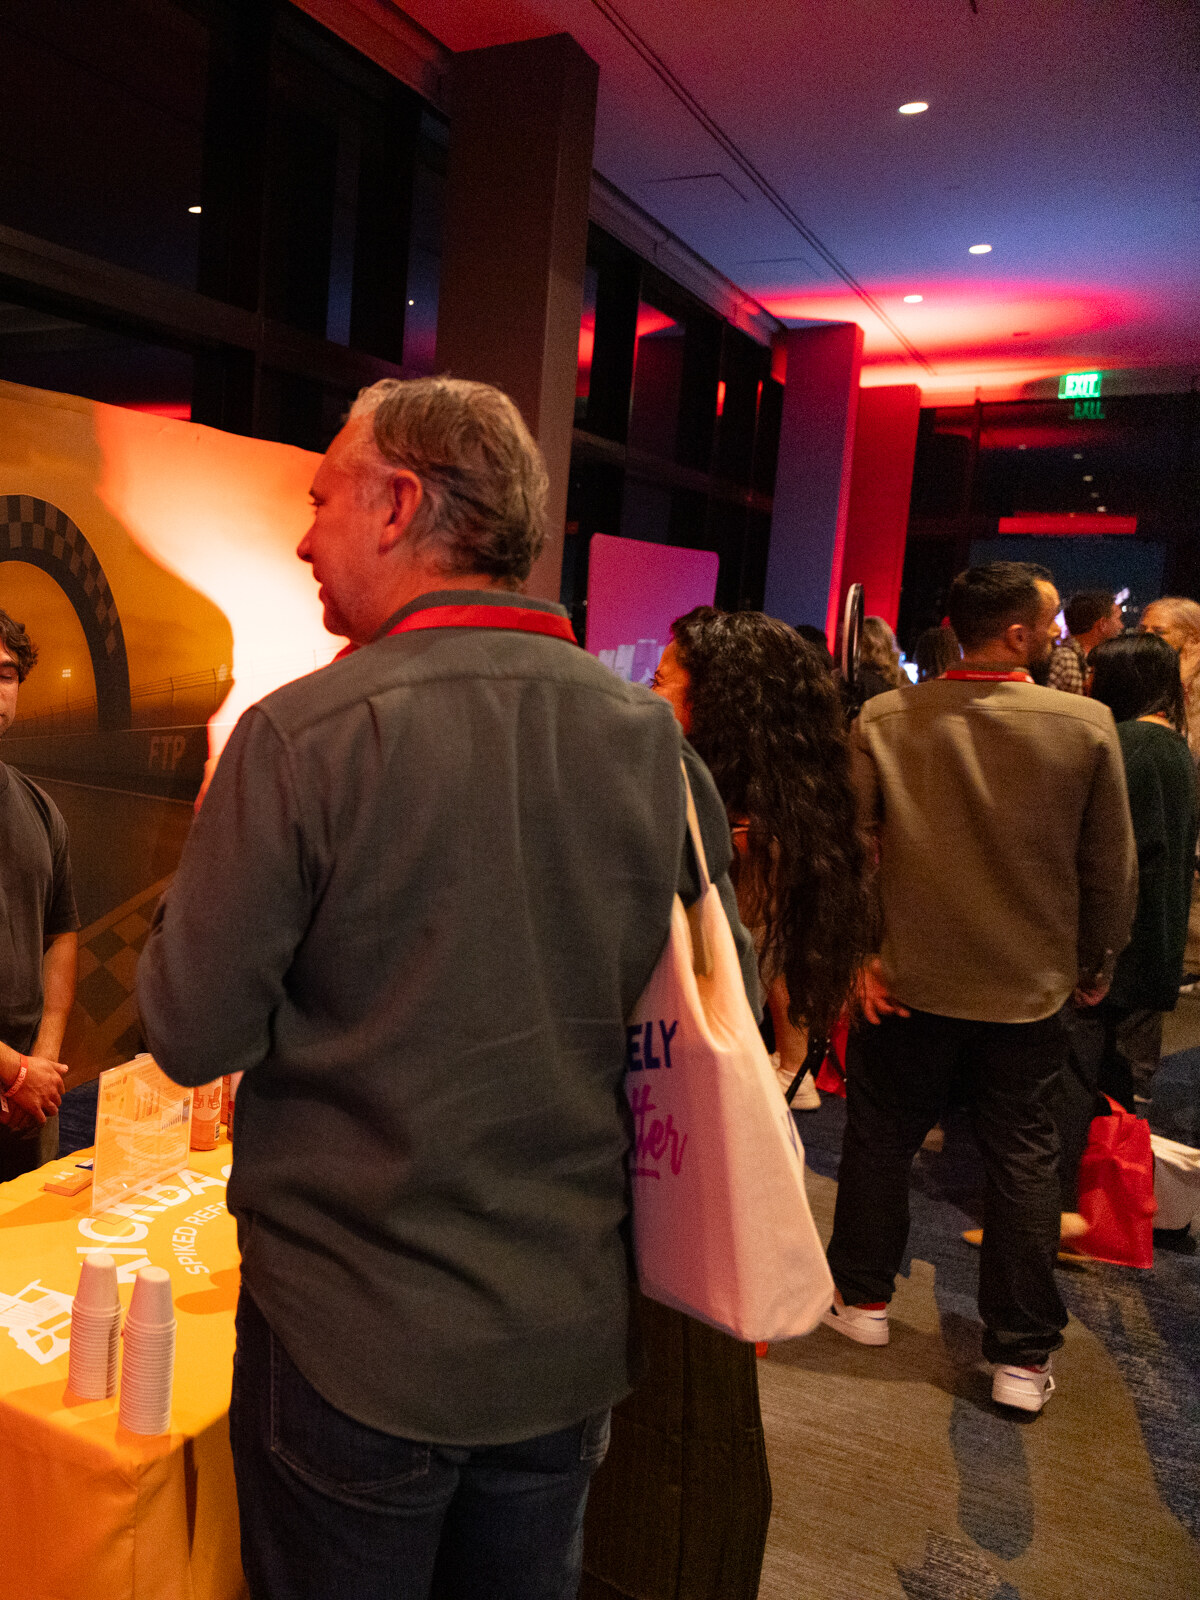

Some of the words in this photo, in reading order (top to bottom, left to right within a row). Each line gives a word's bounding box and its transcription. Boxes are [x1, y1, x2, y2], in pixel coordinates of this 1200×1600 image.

[1065, 373, 1099, 397] EXIT
[148, 735, 186, 770] FTP
[171, 1226, 210, 1275] SPIKED
